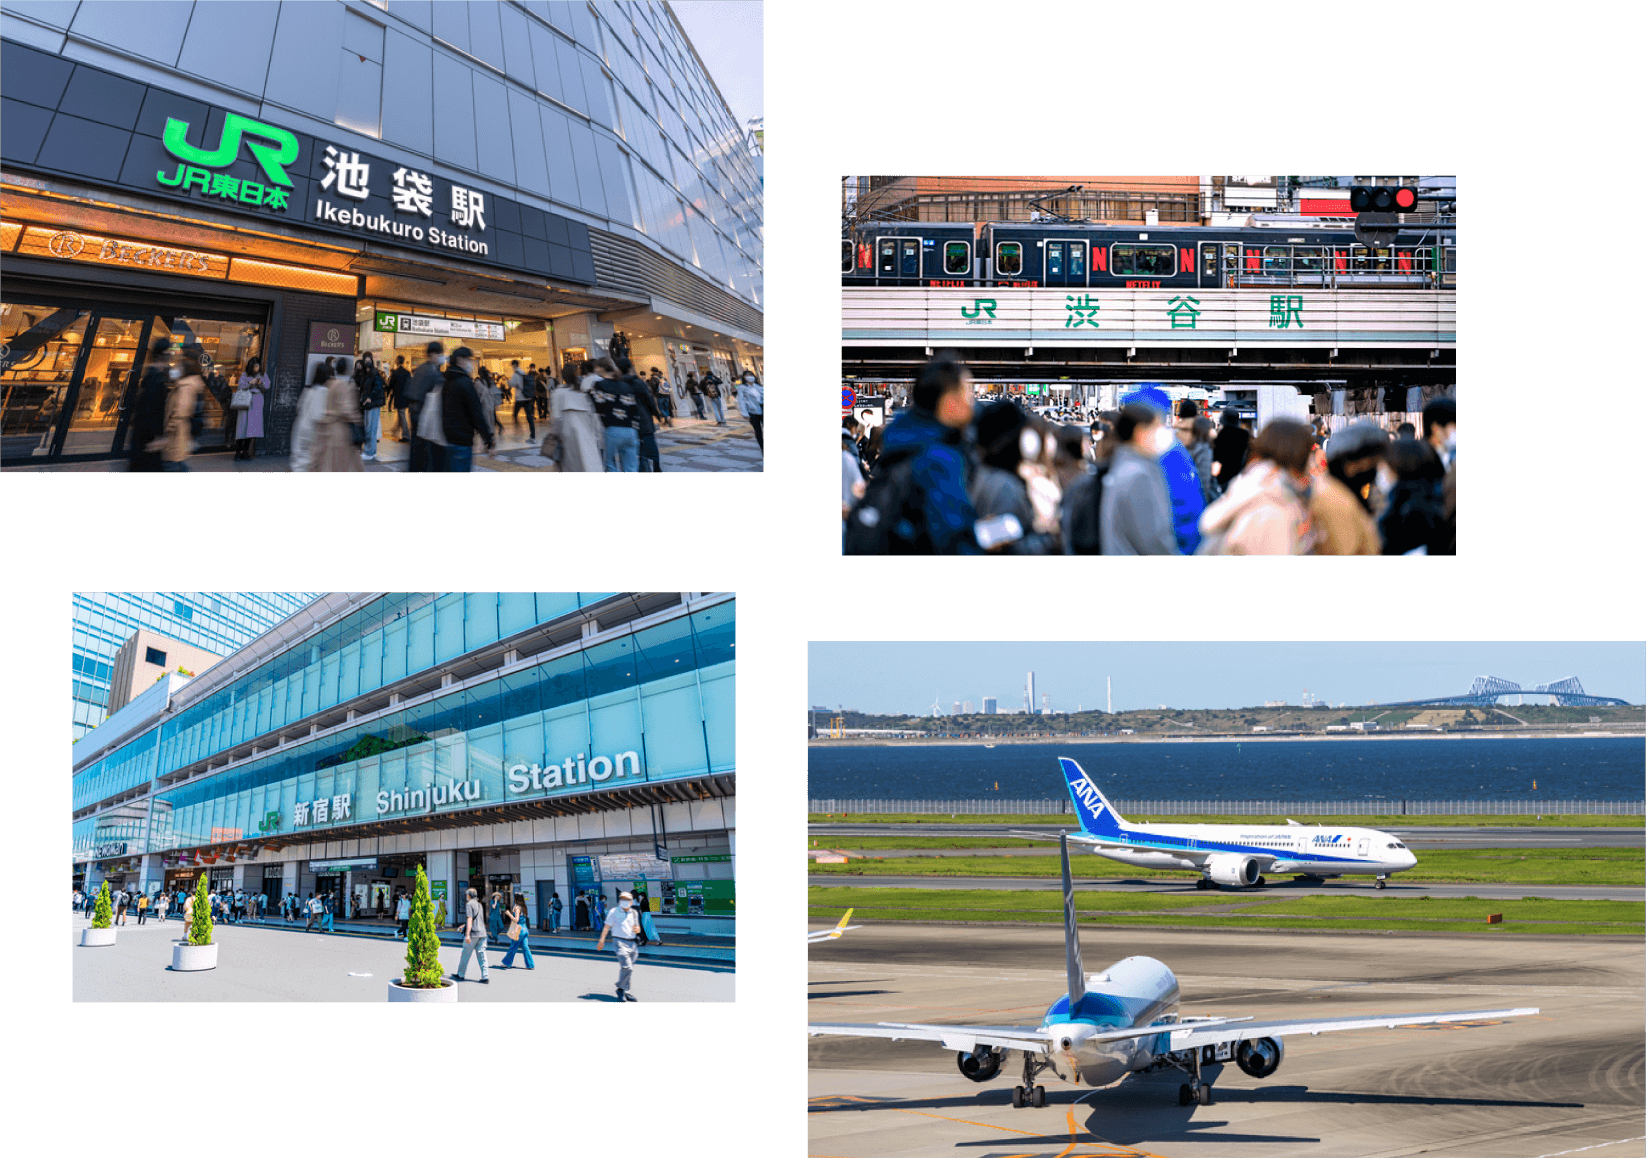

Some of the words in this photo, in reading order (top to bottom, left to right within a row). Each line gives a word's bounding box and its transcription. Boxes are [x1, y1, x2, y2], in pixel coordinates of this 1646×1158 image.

[162, 112, 299, 188] JR
[156, 164, 290, 210] JR東日本
[320, 145, 486, 231] 池袋駅
[316, 200, 424, 241] Ikebukuro
[429, 226, 489, 255] Station
[858, 244, 872, 268] N
[1092, 247, 1107, 271] N
[1180, 248, 1195, 273] N
[1246, 249, 1261, 274] N
[1335, 250, 1347, 275] N
[1398, 251, 1412, 276] N
[1126, 280, 1161, 288] NETFLIX
[379, 315, 395, 326] JR
[961, 298, 997, 318] JR
[1065, 293, 1304, 328] 渋谷駅
[375, 779, 481, 814] Shinjuku
[508, 750, 641, 793] Station
[293, 793, 351, 826] 新宿駅
[1070, 777, 1106, 819] ANA
[259, 811, 279, 832] JR
